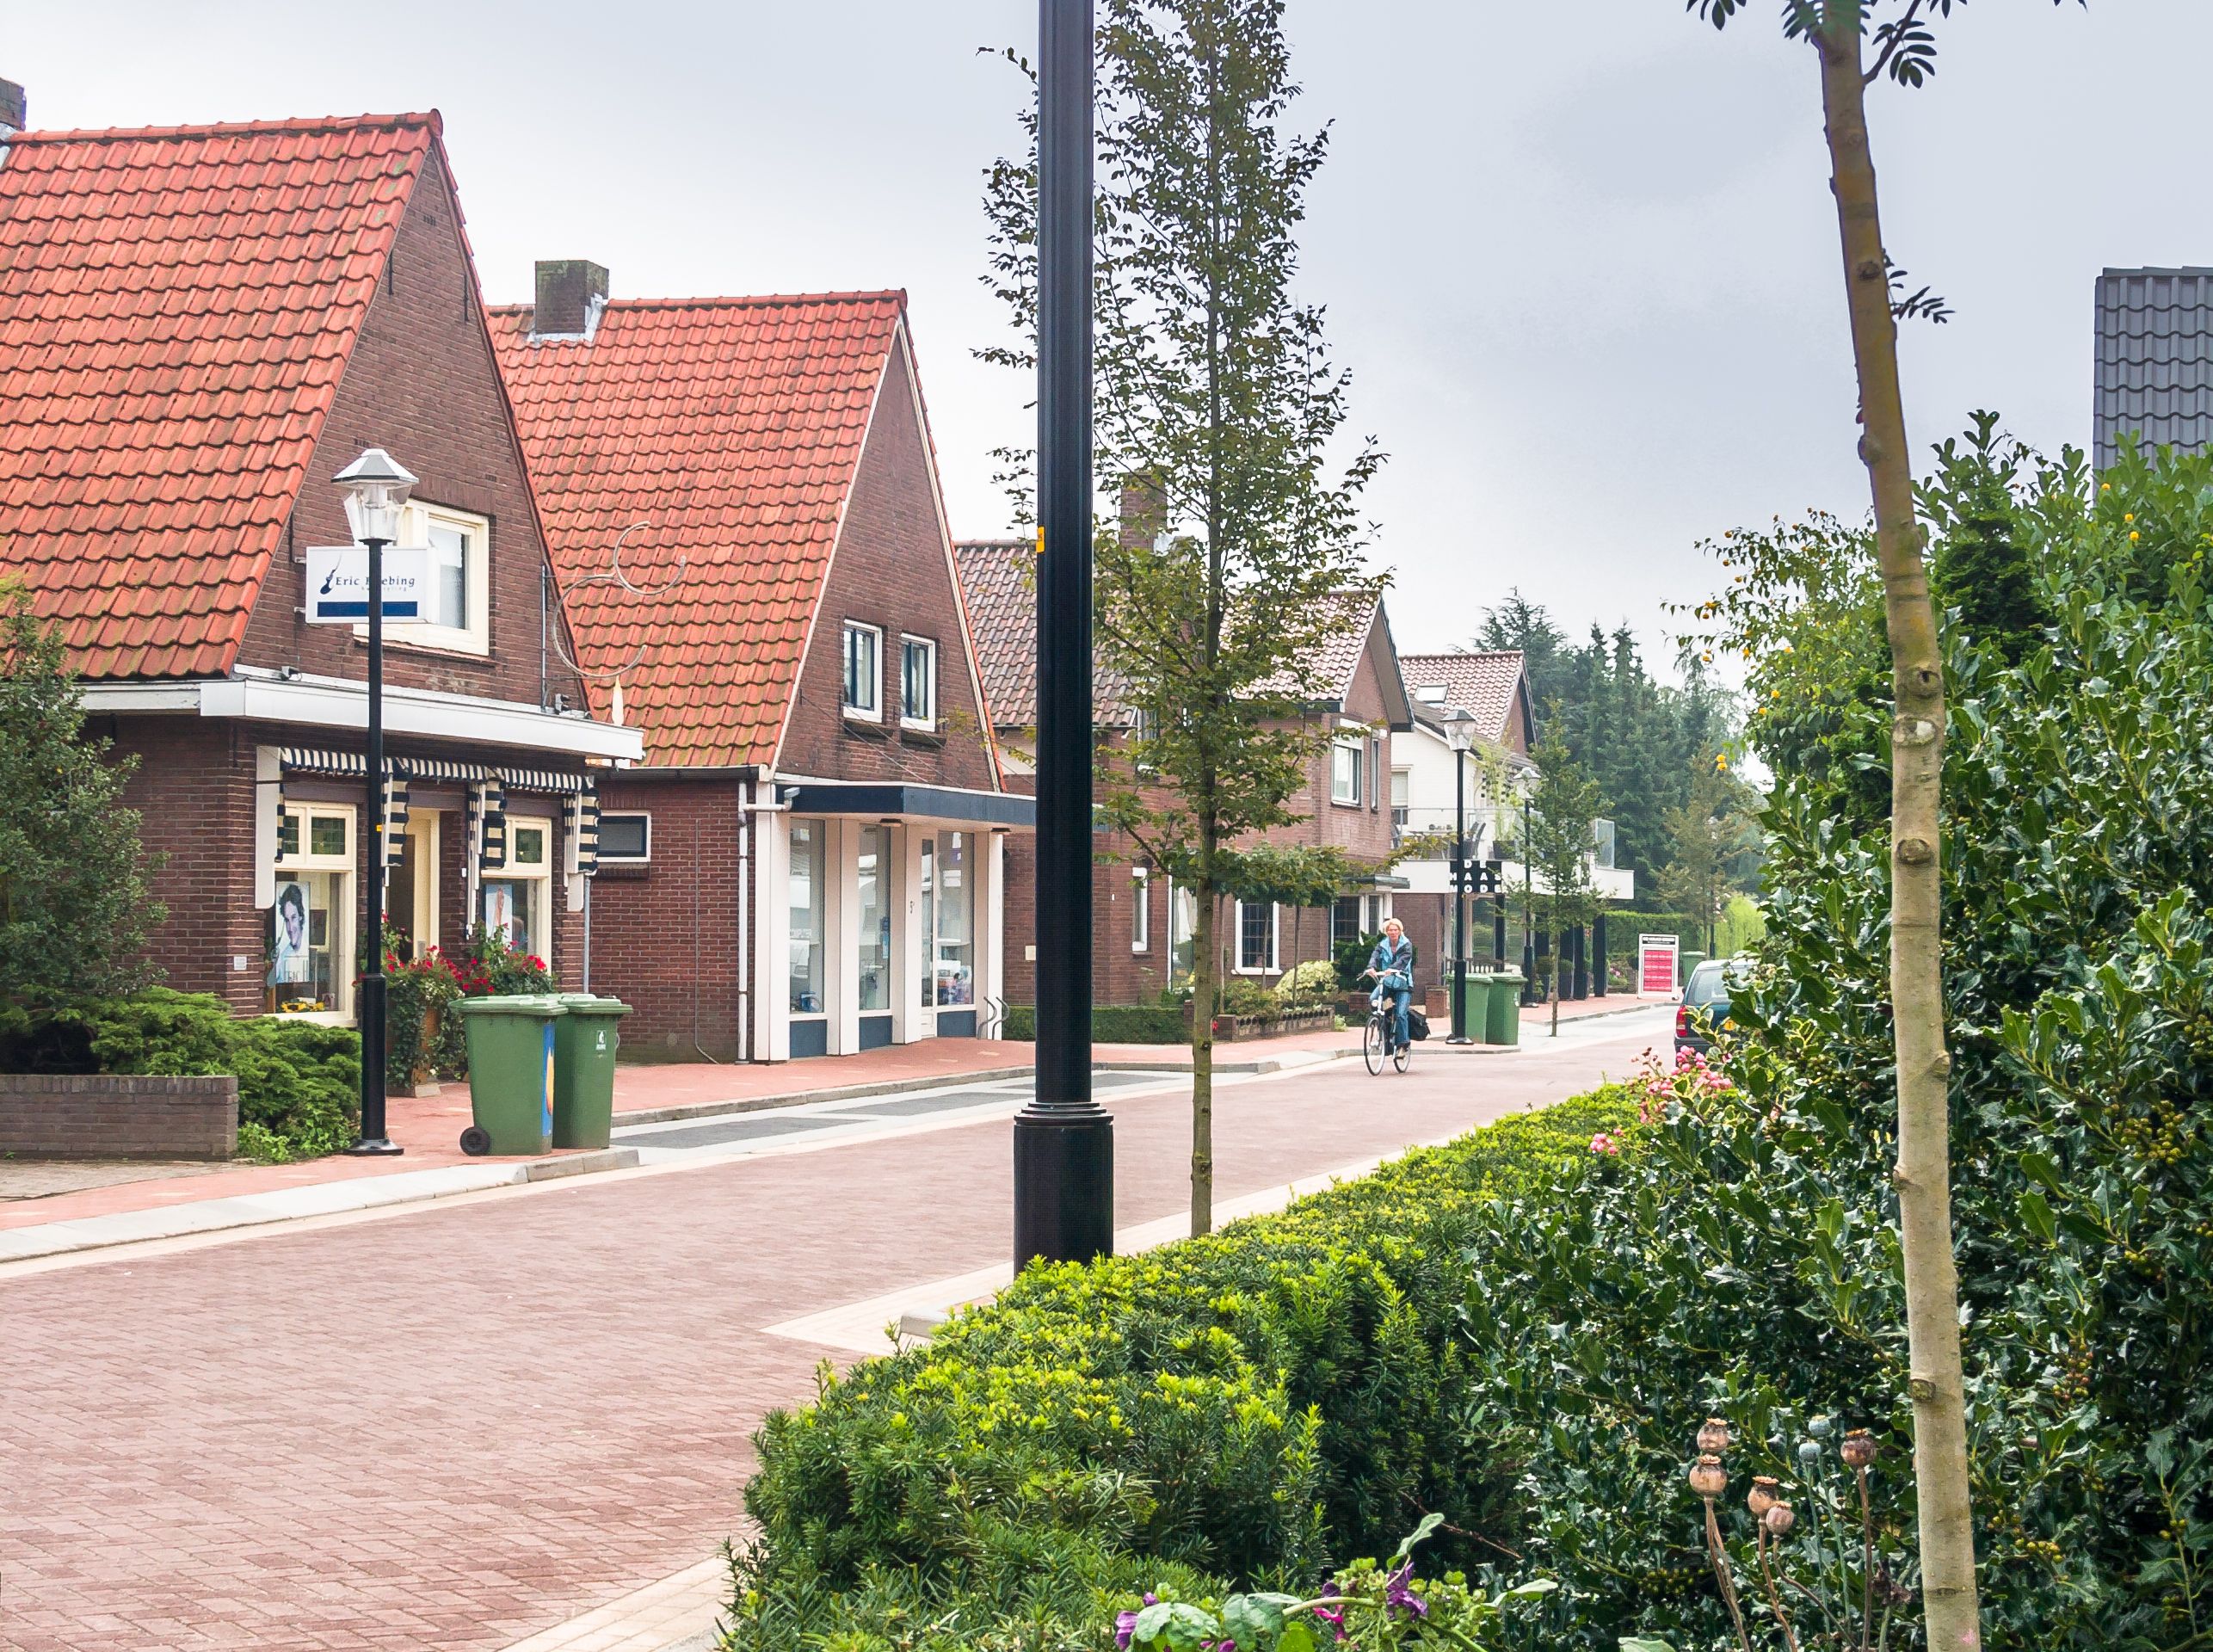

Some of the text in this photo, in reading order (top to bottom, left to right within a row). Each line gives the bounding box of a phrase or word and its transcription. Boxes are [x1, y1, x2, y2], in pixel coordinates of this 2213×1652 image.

[336, 576, 415, 588] Eric ebing
[1464, 860, 1487, 869] DE
